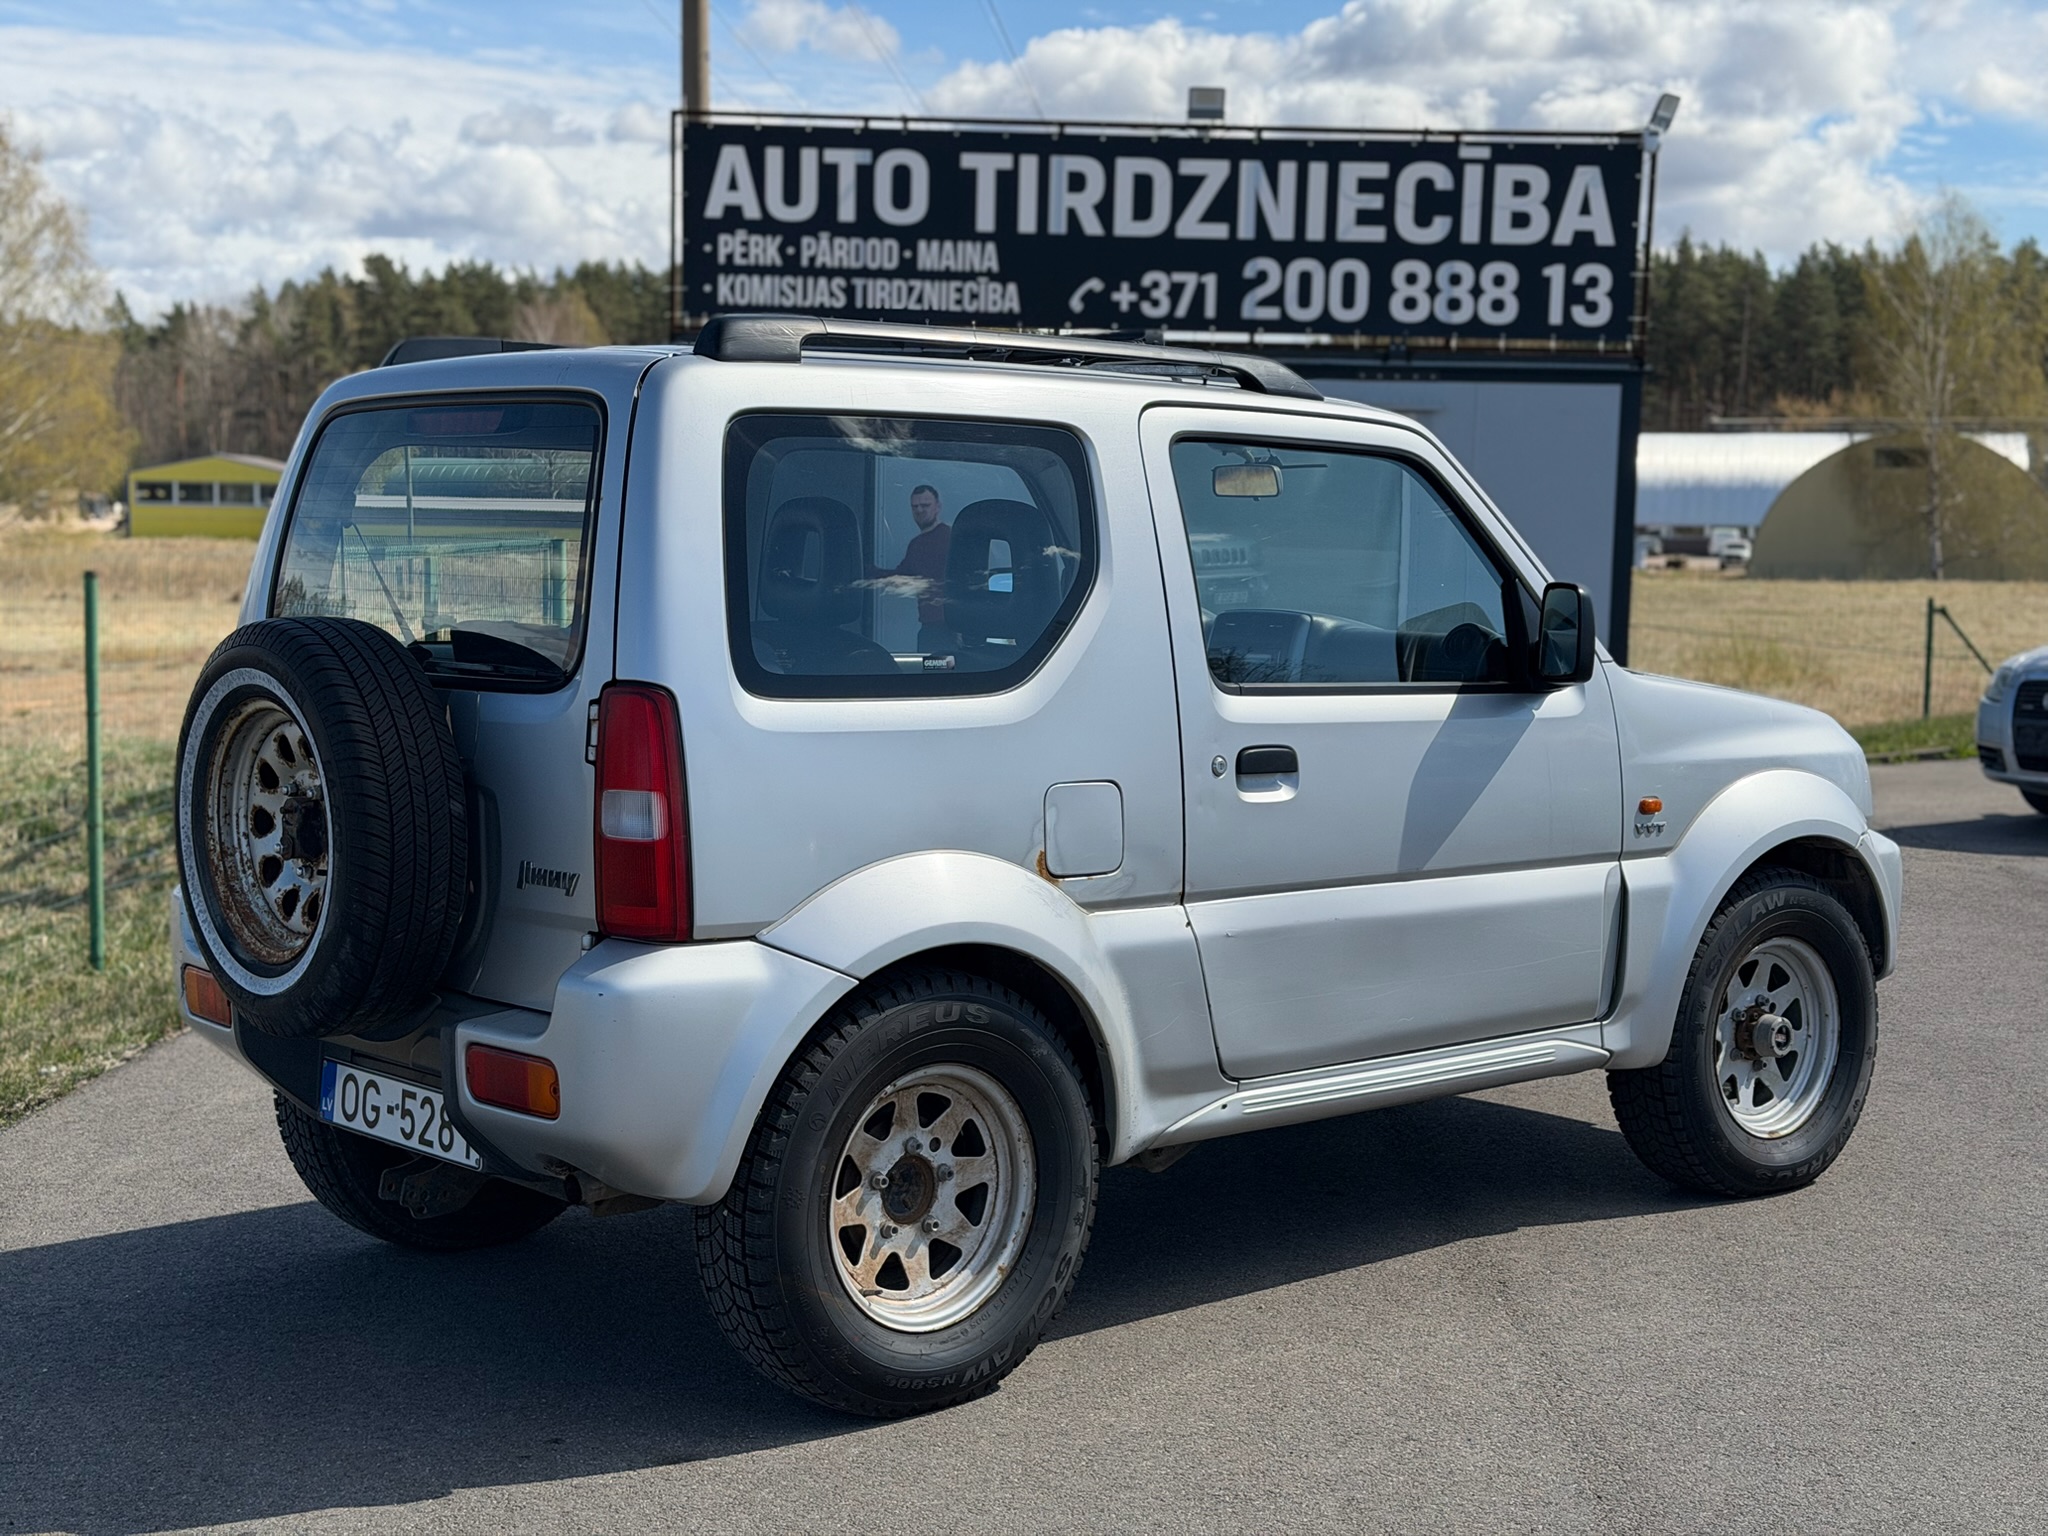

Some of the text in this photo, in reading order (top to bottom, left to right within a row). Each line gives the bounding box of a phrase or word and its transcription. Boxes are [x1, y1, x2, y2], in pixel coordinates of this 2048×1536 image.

[703, 143, 1616, 247] AUTO TIRDZNIECĪBA
[717, 229, 1000, 274] PĒRK PĀRDOD MAINA
[716, 273, 1021, 314] KOMISIJAS TIRDZNIECĪBA
[1111, 256, 1614, 328] +371 200 888 13
[1634, 822, 1667, 837] VVT
[321, 1096, 334, 1112] LV
